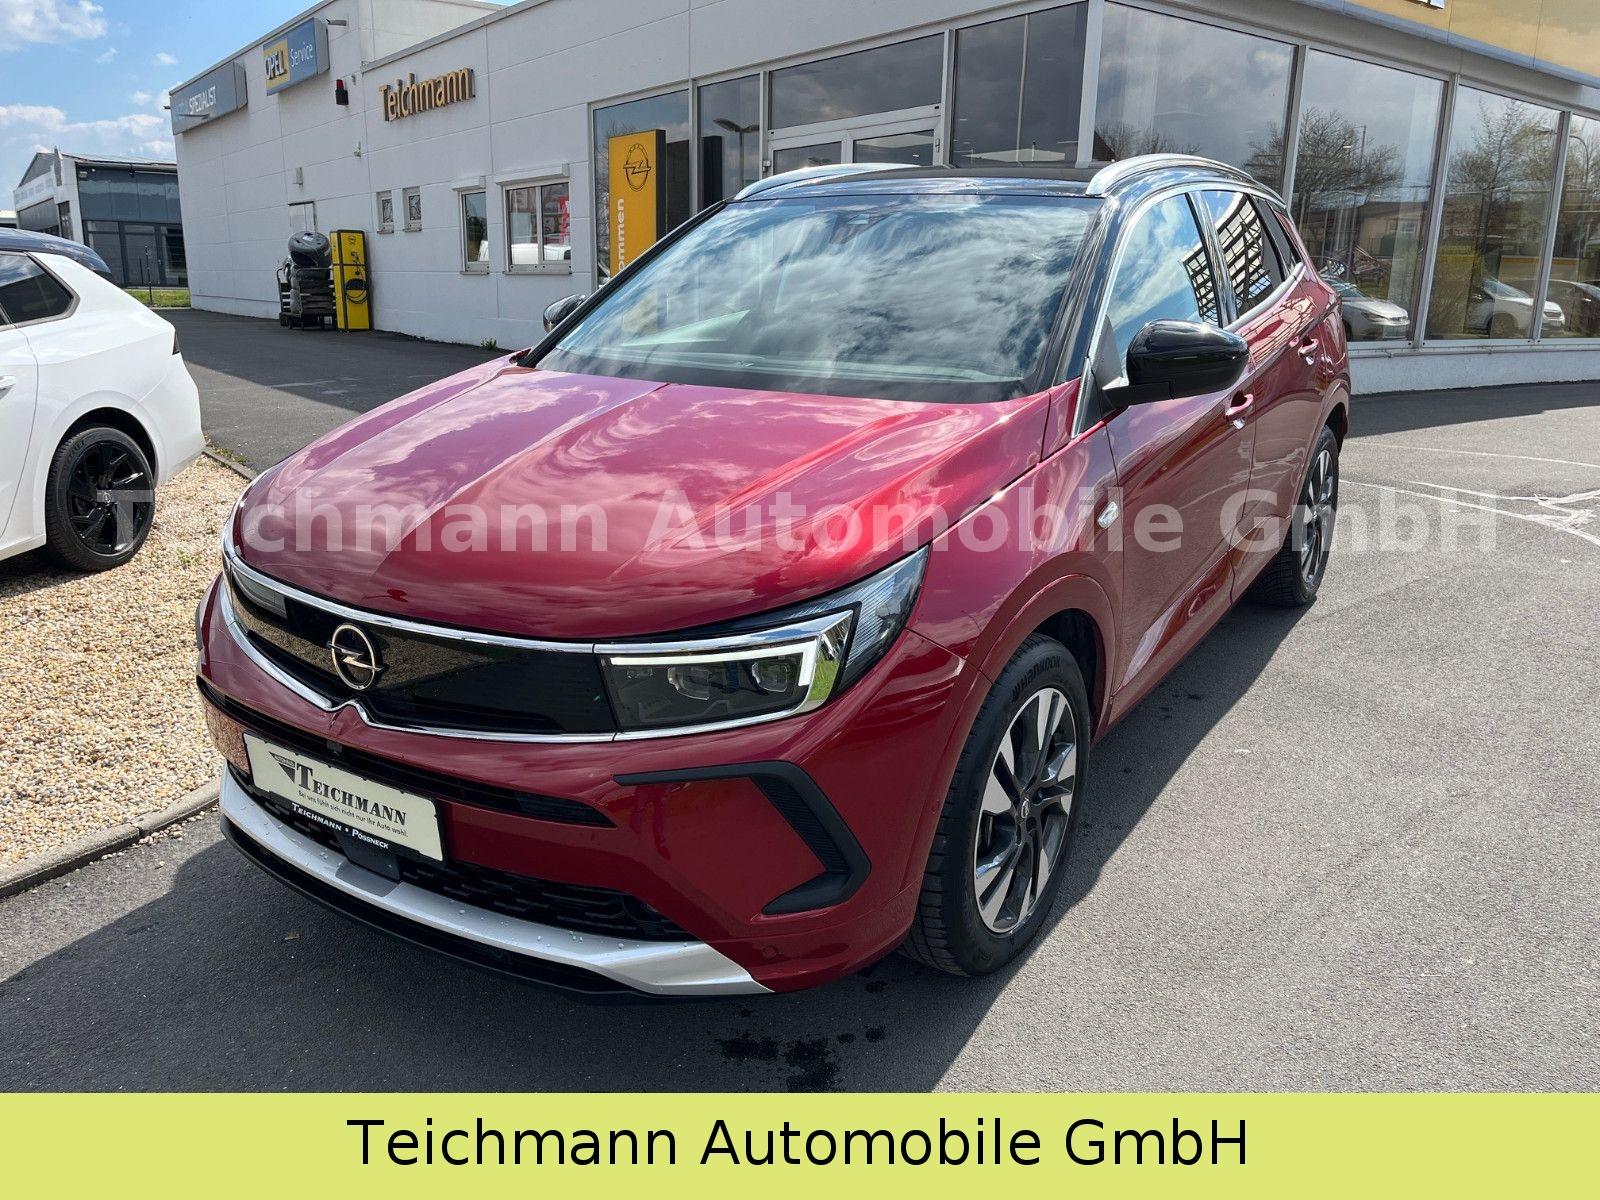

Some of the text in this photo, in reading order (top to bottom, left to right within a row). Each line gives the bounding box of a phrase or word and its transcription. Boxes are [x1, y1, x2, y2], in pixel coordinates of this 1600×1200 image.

[265, 41, 313, 80] OPEL Service
[378, 67, 471, 122] Teichmann
[296, 762, 407, 826] TEICHMANN
[292, 802, 342, 831] TEICHMANN
[377, 821, 391, 831] Auto
